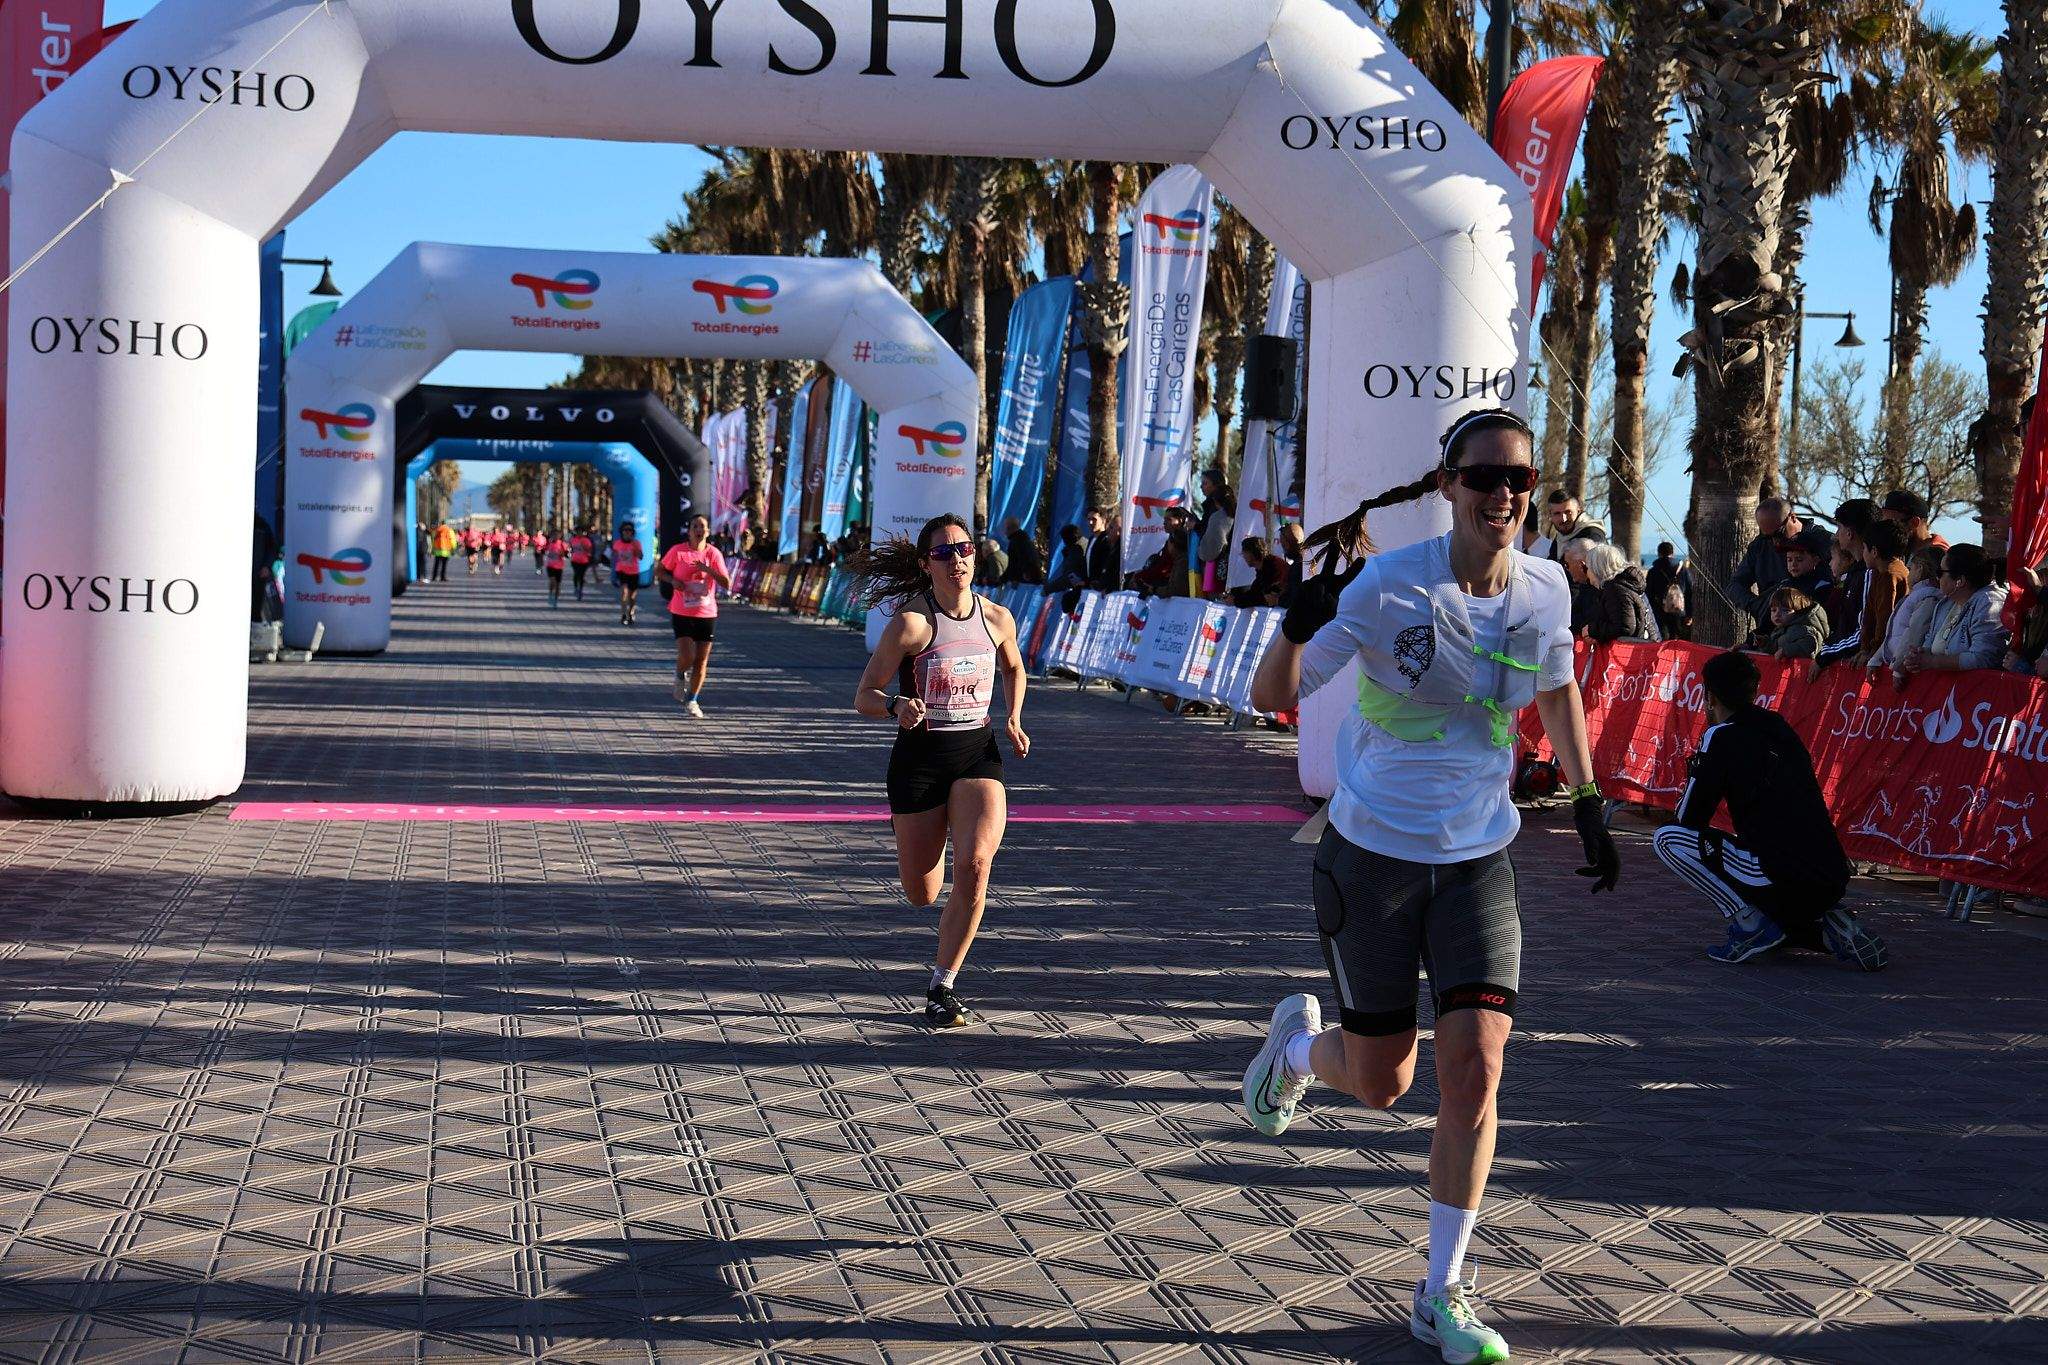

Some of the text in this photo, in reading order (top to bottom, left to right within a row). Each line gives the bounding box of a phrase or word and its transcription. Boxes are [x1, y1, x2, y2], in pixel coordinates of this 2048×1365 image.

[122, 65, 315, 111] OYSHO
[1280, 115, 1447, 152] OYSHO
[1142, 245, 1203, 257] TotalEnergies
[31, 316, 208, 360] OYSHO
[510, 316, 601, 331] TotalEnergies
[691, 322, 779, 336] TotalEnergies
[1164, 292, 1190, 414] LasCarreras
[1364, 364, 1516, 401] OYSHO
[453, 404, 615, 423] VOLVO
[996, 352, 1048, 467] Marlene
[299, 447, 376, 462] TotalEnergies
[895, 462, 965, 477] TotalEnergies
[23, 573, 199, 615] OYSHO
[296, 592, 372, 605] TotalEnergies
[1599, 662, 1657, 709] Sports
[1831, 692, 1923, 750] Sports
